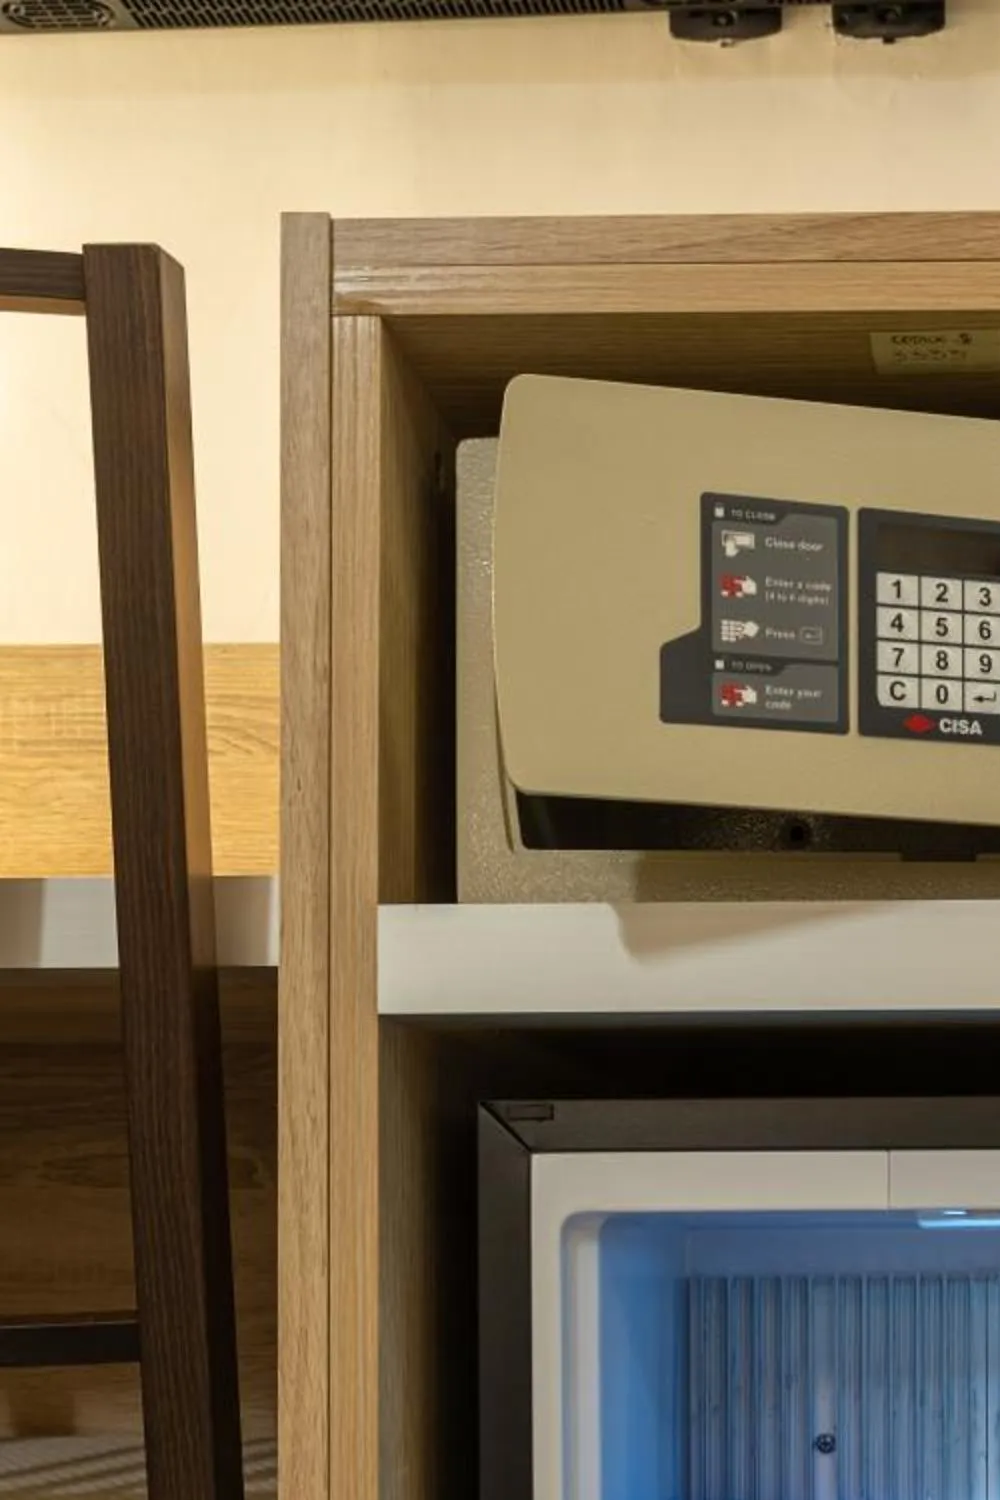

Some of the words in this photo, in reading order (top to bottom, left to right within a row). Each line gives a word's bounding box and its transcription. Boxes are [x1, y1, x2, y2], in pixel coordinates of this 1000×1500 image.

[764, 536, 796, 550] Close
[797, 540, 823, 553] door
[764, 576, 794, 591] Enter
[804, 581, 832, 594] code
[892, 580, 902, 600] 1
[935, 582, 949, 604] 2
[978, 586, 992, 608] 3
[764, 627, 797, 641] Press
[889, 613, 904, 634] 4
[935, 617, 949, 638] 5
[978, 620, 992, 641] 6
[891, 647, 905, 668] 7
[935, 650, 949, 671] 8
[978, 653, 993, 674] 9
[764, 684, 795, 698] Enter
[796, 687, 823, 701] your
[888, 680, 907, 702] C
[936, 684, 949, 705] 0
[764, 699, 793, 712] code
[938, 717, 984, 737] CISA
